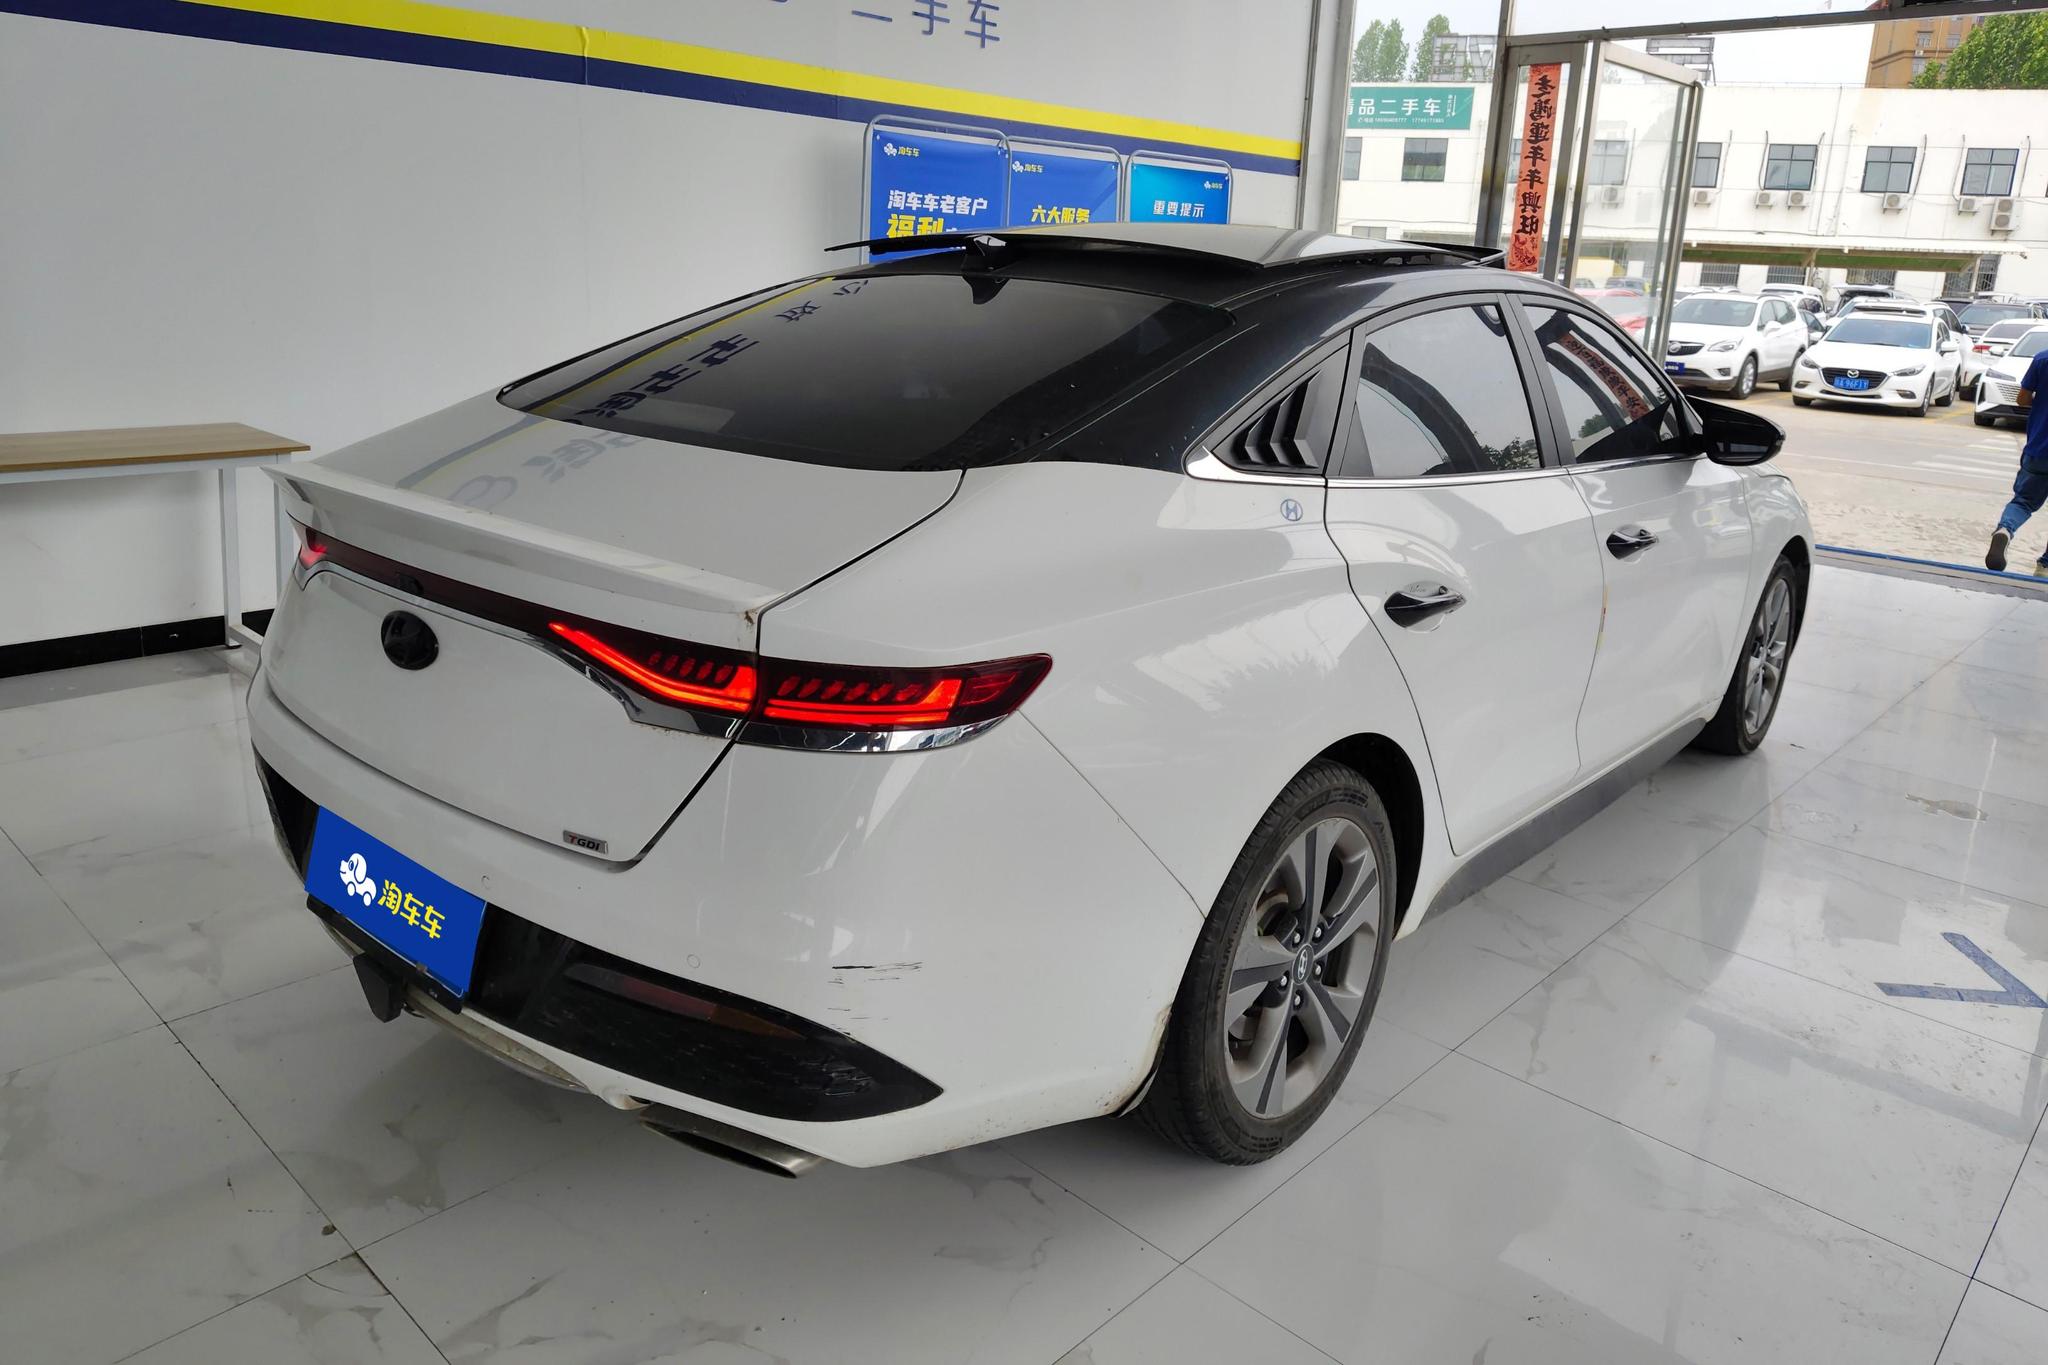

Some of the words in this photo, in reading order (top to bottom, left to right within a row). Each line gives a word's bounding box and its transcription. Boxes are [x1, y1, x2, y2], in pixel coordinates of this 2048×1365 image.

[887, 189, 988, 216] 淘车车老客户
[1153, 200, 1205, 218] 重要提示
[1031, 204, 1091, 224] 六大服务
[886, 213, 944, 238] 福利
[569, 834, 600, 851] TGDI
[378, 879, 445, 939] 淘车车
